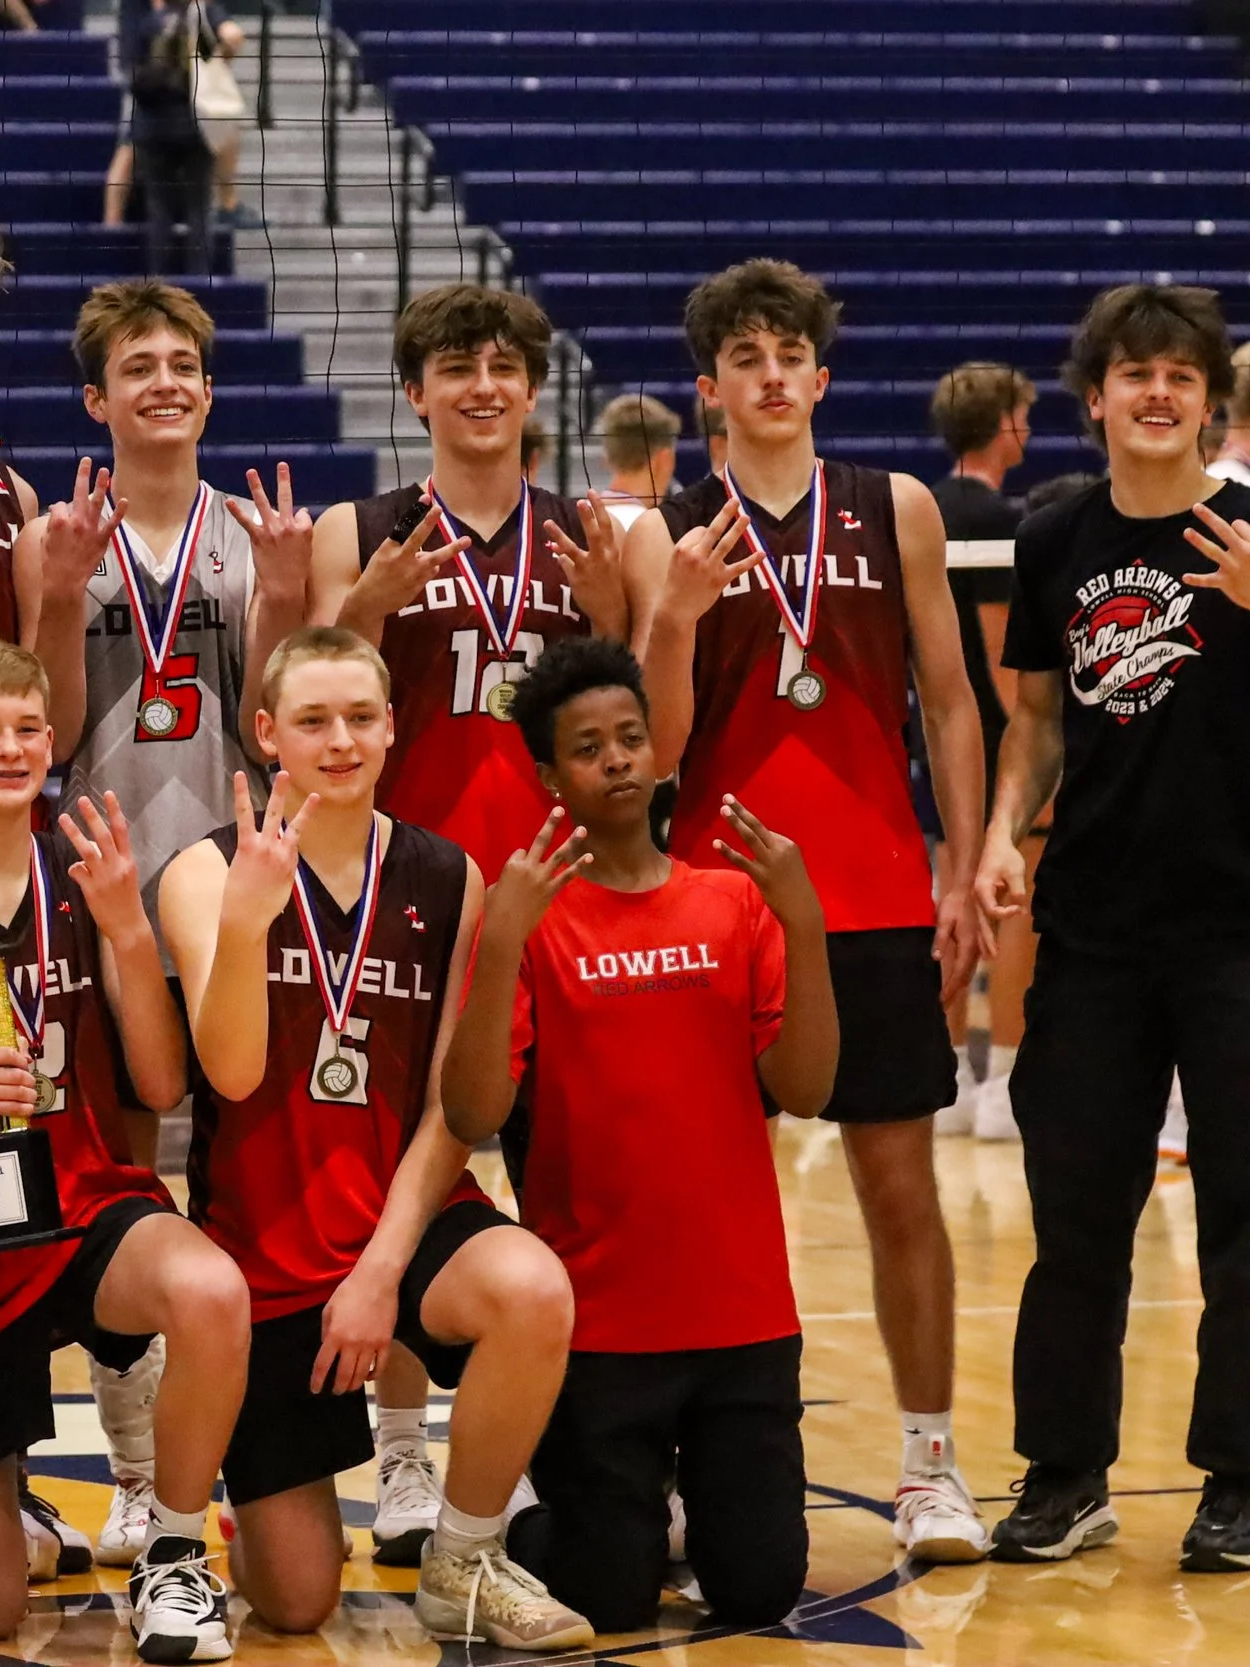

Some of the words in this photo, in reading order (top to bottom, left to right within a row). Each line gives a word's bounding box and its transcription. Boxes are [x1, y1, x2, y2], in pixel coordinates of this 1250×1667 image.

[1076, 573, 1110, 607] RED
[1113, 566, 1182, 600] ARROWS
[1071, 593, 1194, 675] Volleyball
[1097, 674, 1126, 700] State
[1127, 646, 1174, 678] Champs
[1104, 698, 1136, 715] 2023
[1139, 699, 1149, 713] &
[1150, 676, 1175, 708] 2024
[134, 653, 203, 743] 5
[577, 944, 720, 981] LOWELL
[593, 981, 630, 997] RED
[634, 974, 710, 995] ARROWS
[309, 1015, 370, 1106] 6
